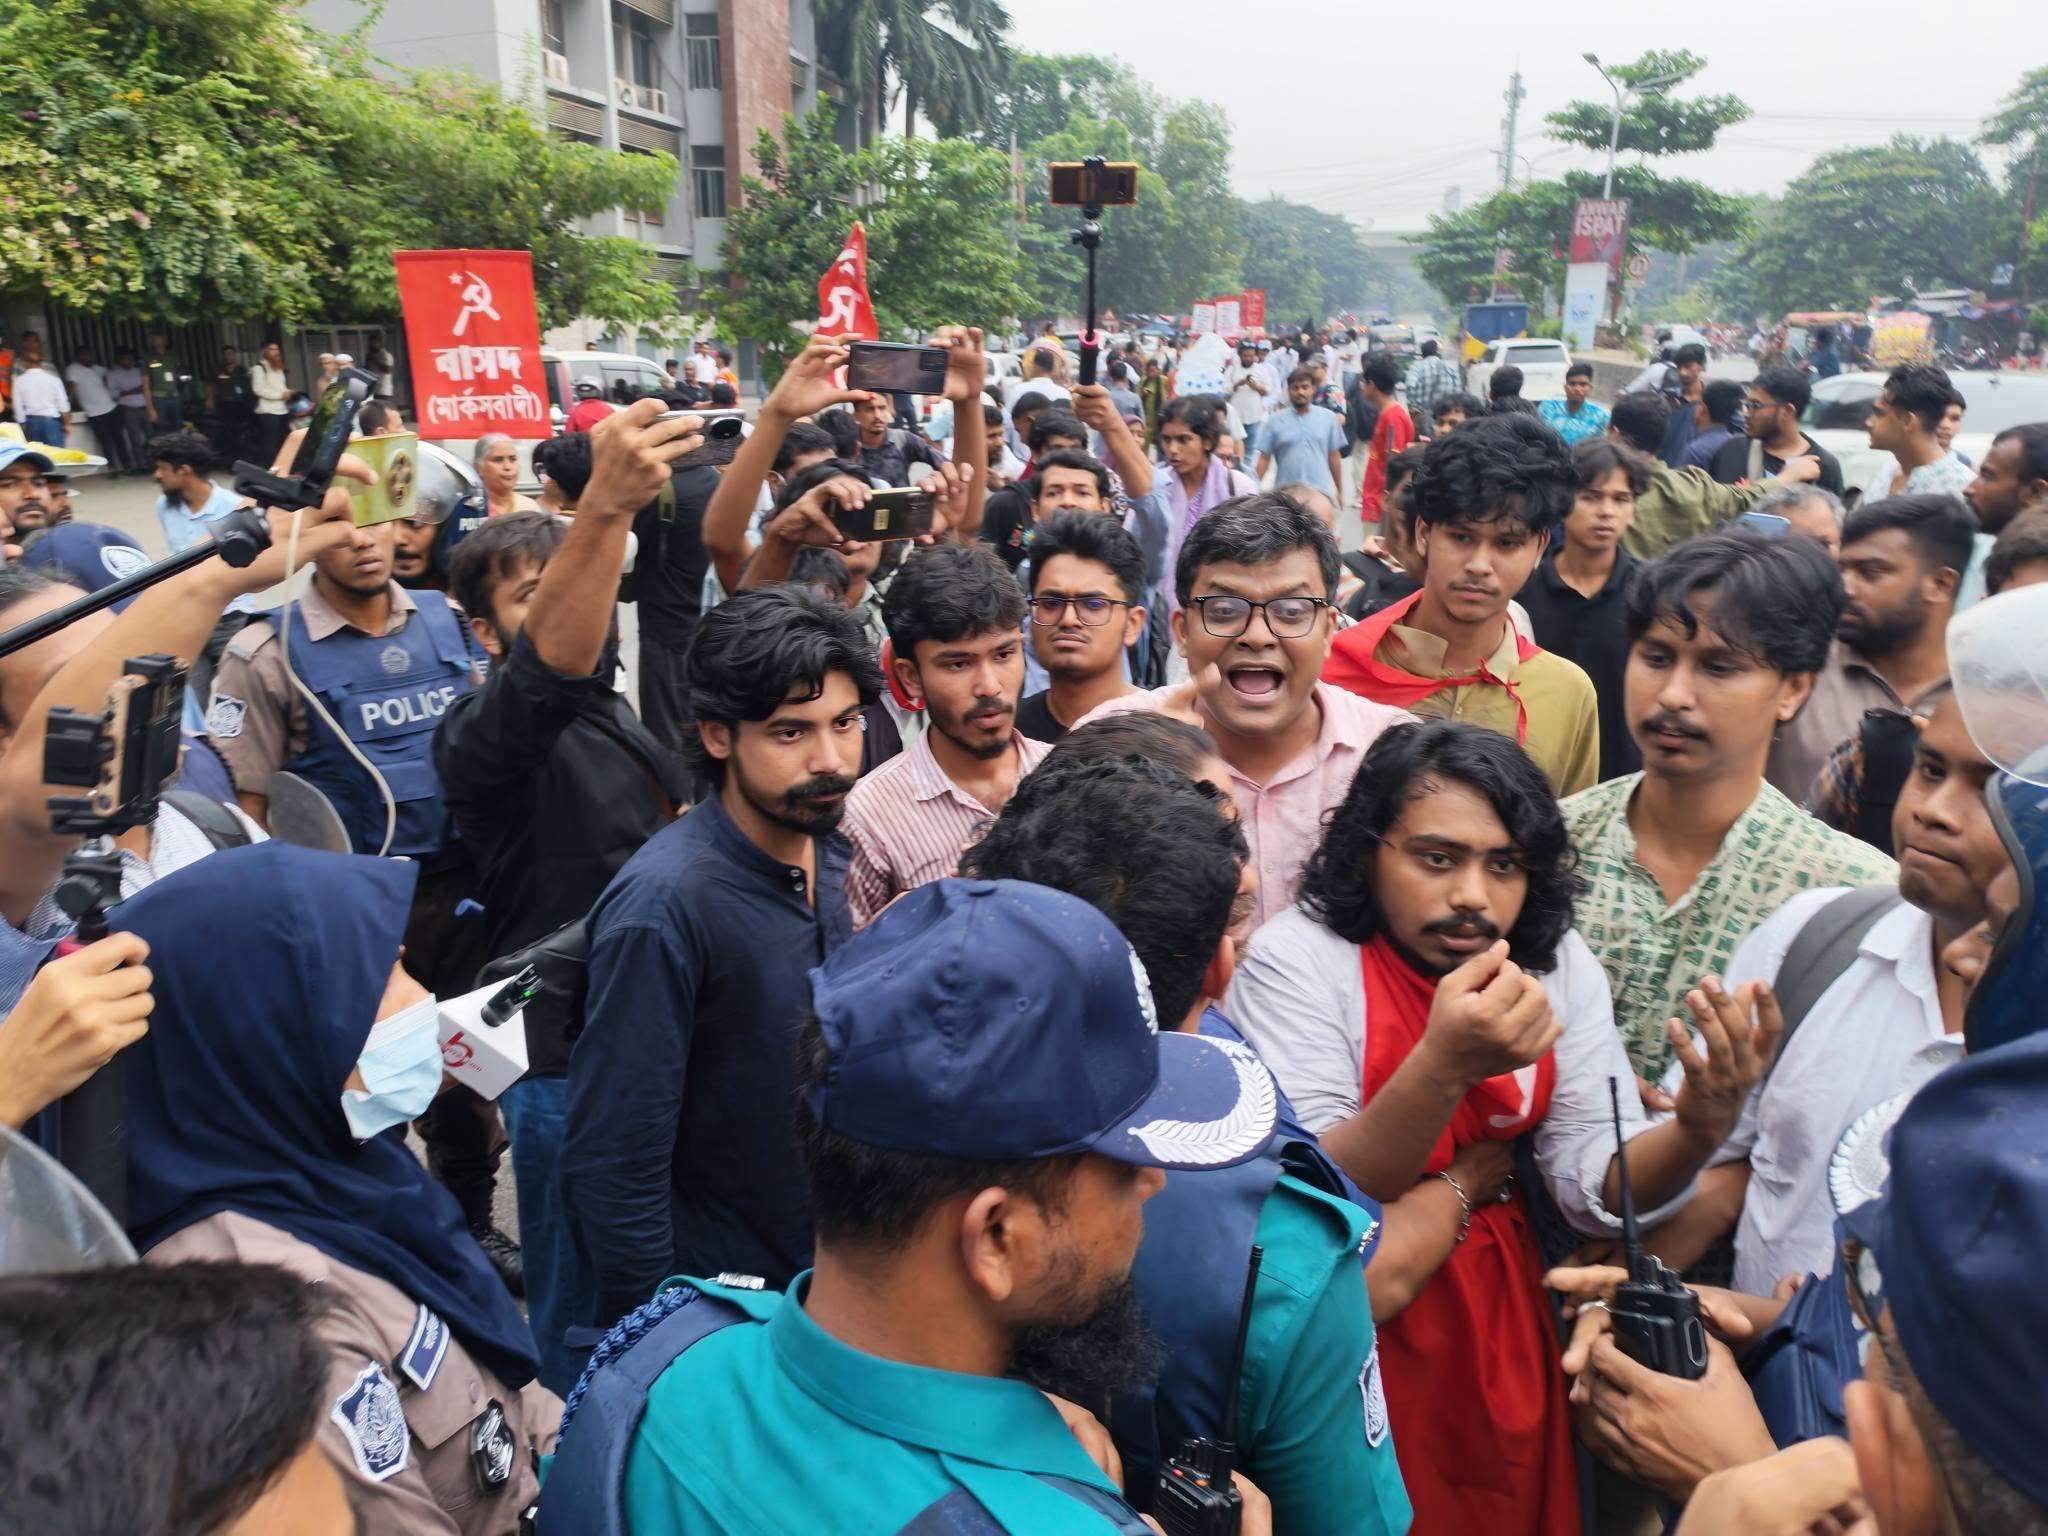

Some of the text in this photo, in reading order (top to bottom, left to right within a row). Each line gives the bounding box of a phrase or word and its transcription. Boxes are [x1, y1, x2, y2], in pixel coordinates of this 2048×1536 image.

[1573, 216, 1627, 237] ISPAT
[430, 345, 522, 381] বাসদ
[427, 384, 543, 424] (মার্কসবাদী)
[360, 686, 457, 731] POLICE
